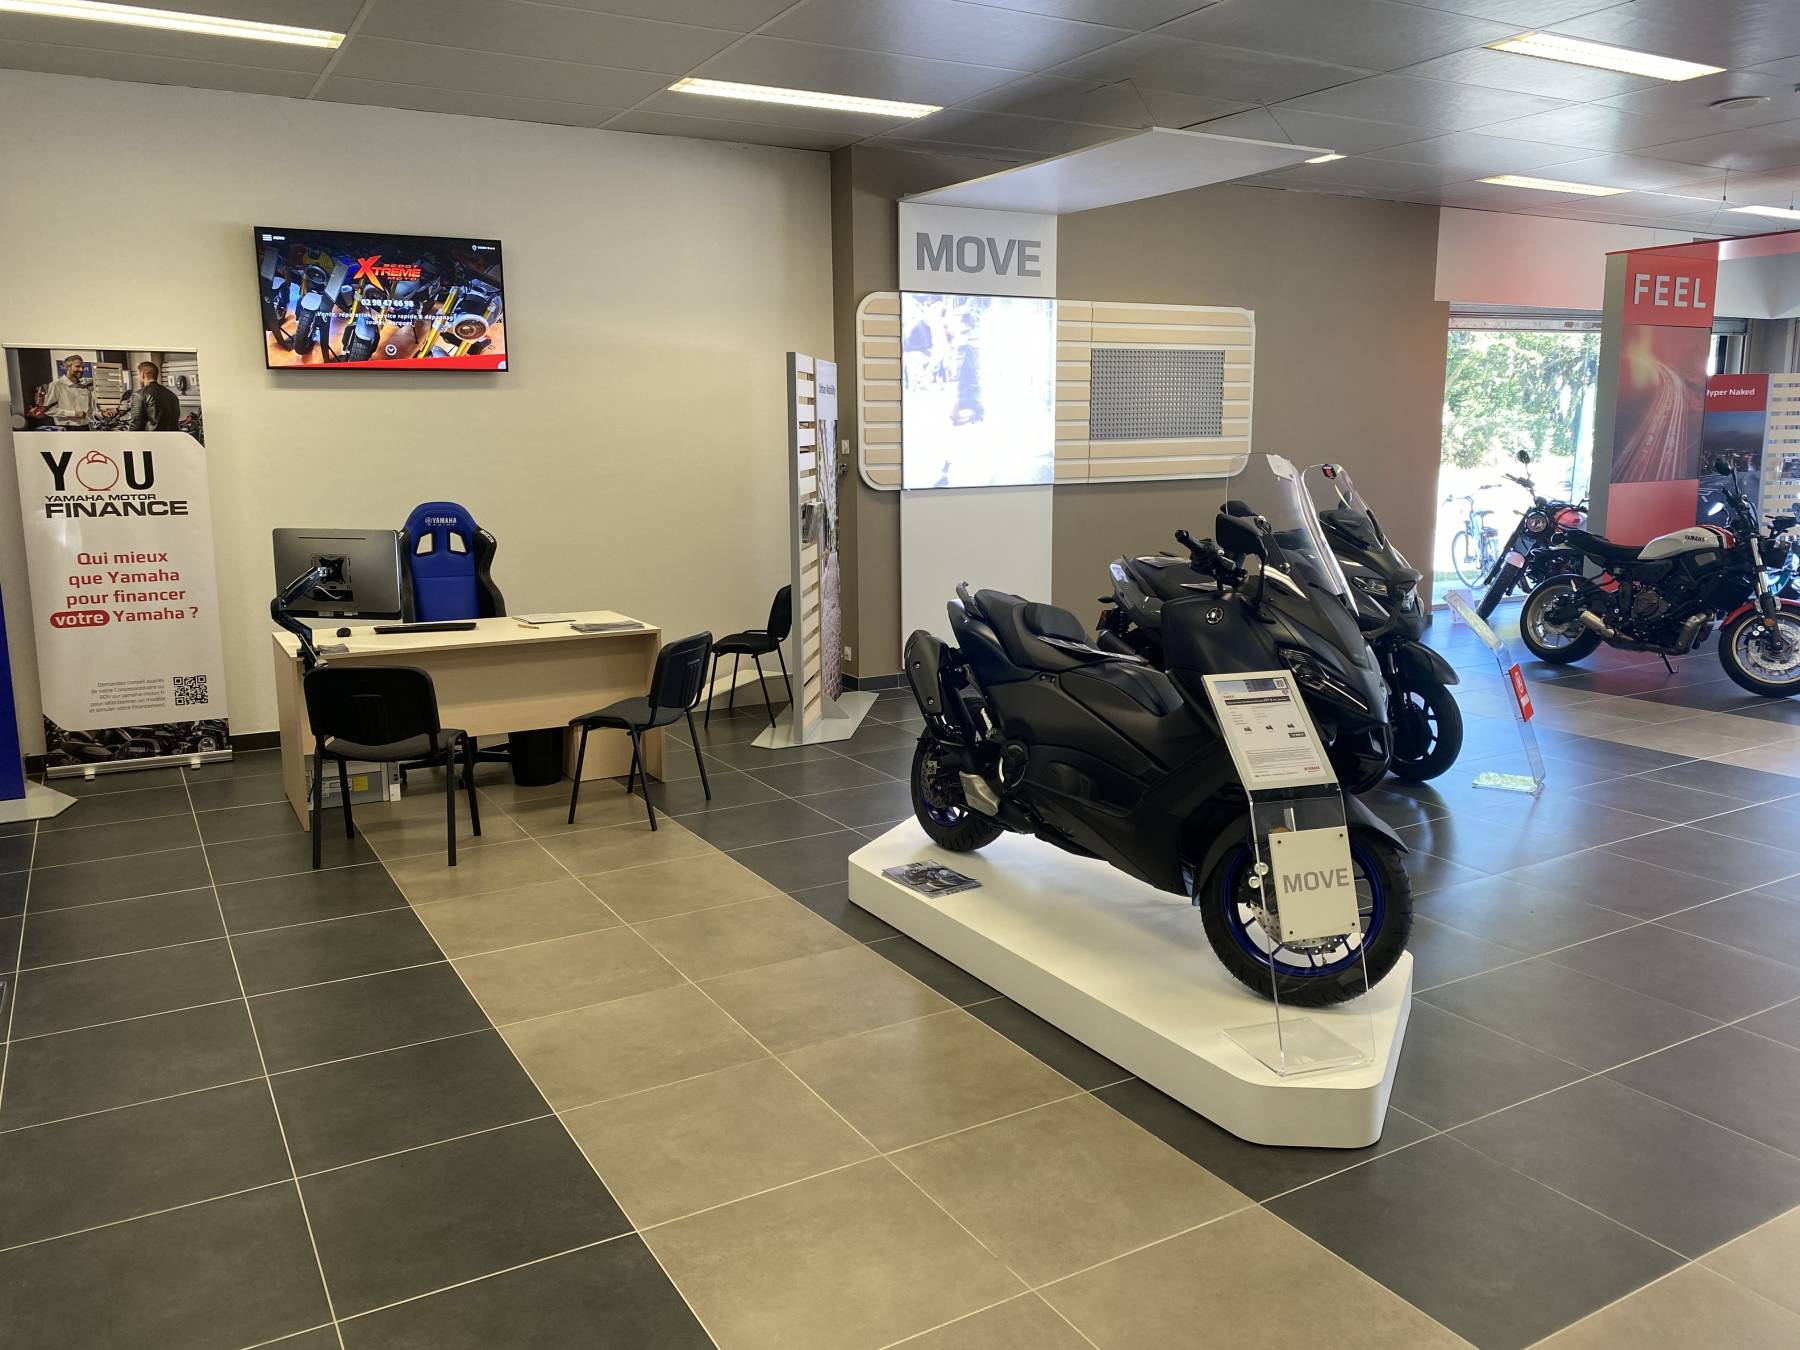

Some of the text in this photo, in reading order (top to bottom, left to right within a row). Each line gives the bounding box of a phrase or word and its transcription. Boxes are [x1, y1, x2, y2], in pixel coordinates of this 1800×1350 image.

[916, 232, 1042, 278] MOVE
[1633, 273, 1707, 309] FEEL
[1729, 388, 1755, 396] Naked
[45, 493, 156, 502] YAMAHA MOTOR
[45, 501, 189, 518] FINANCE
[77, 551, 168, 566] Qui mieux
[68, 569, 180, 589] que Yamaha
[66, 589, 186, 608] pour financer
[55, 606, 199, 626] votre Yamaha ?
[1282, 867, 1350, 894] MOVE
